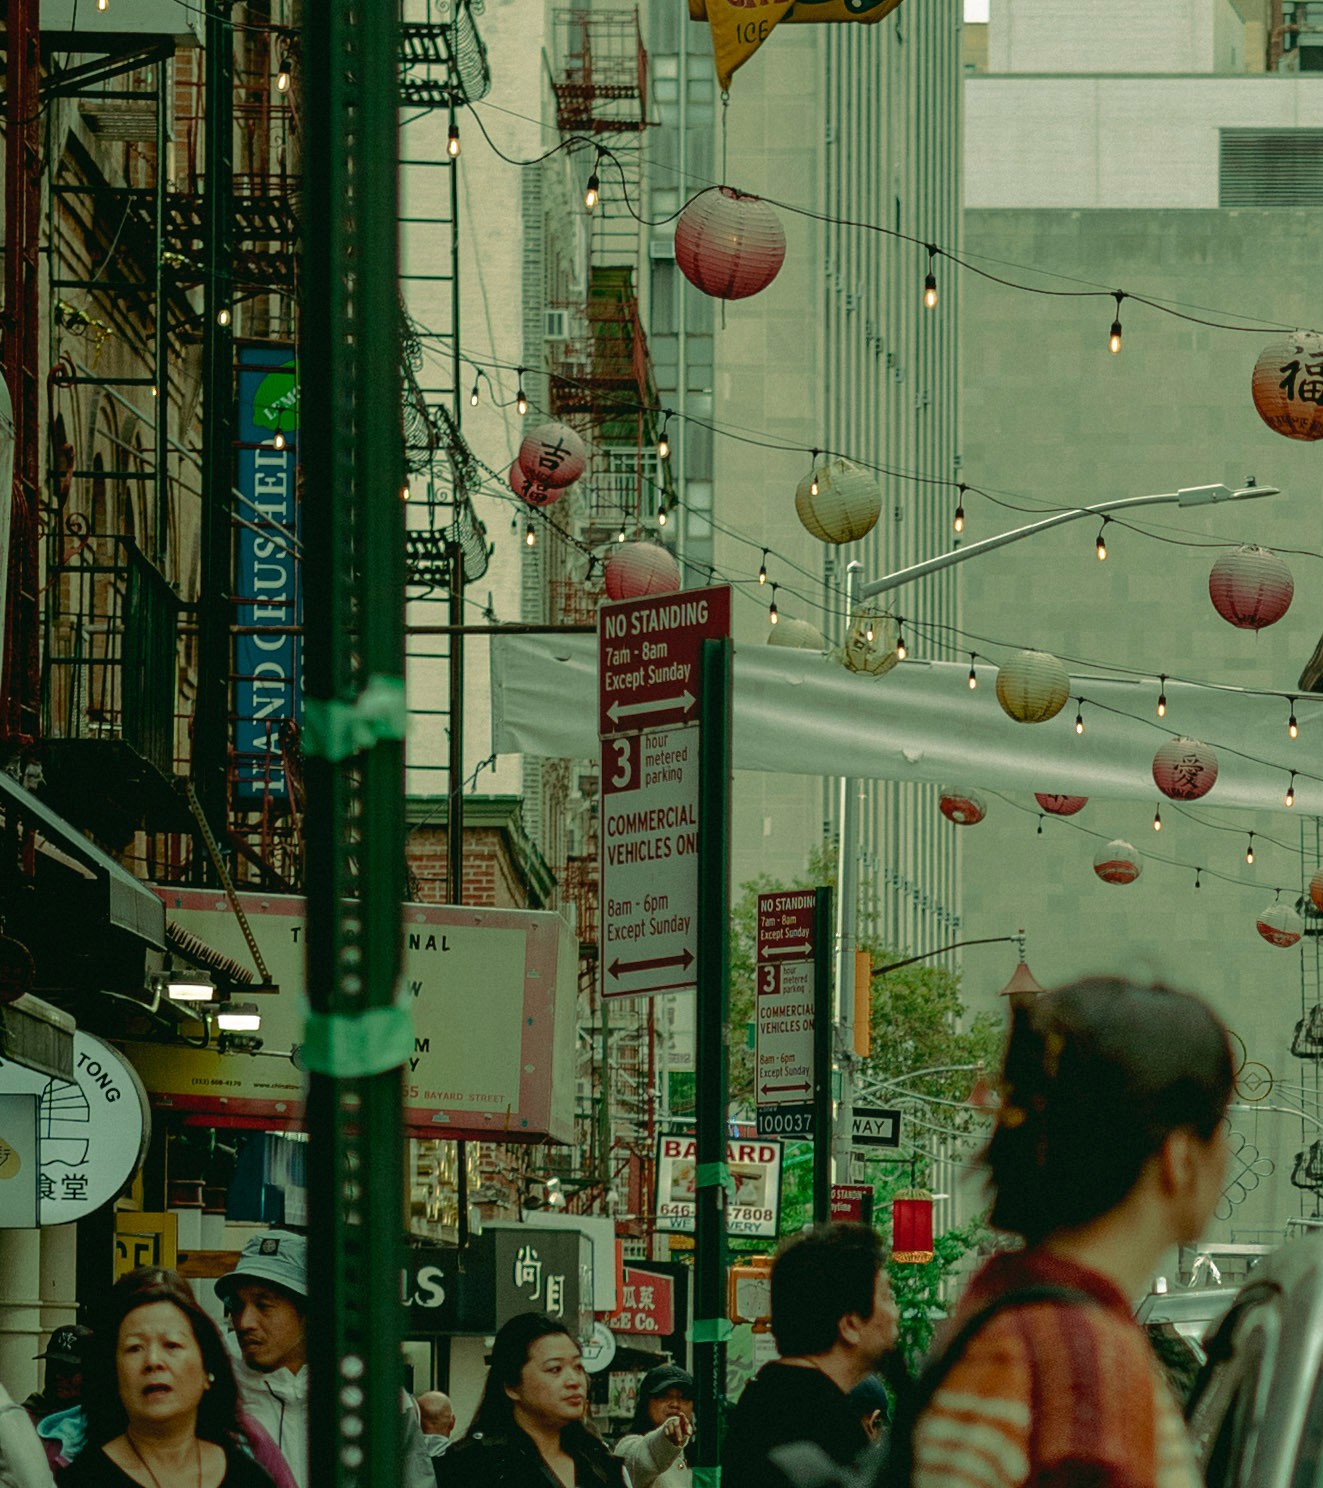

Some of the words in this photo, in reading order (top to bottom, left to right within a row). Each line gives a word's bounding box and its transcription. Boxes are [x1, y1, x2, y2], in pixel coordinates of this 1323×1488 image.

[737, 20, 768, 44] ICE
[540, 437, 572, 471] 吉
[252, 438, 288, 651] CRUSHED
[606, 614, 627, 640] NO
[631, 600, 708, 635] STANDING
[606, 647, 630, 666] 7am
[642, 642, 668, 661] 8am
[605, 667, 645, 691] Except
[648, 663, 691, 685] Sunday
[252, 662, 287, 793] HAND
[645, 733, 668, 750] hour
[611, 738, 632, 788] 3
[645, 748, 688, 768] metered
[645, 767, 683, 788] parking
[1173, 754, 1204, 788] 愛
[607, 804, 697, 838] COMMERCIAL
[608, 836, 672, 866] VEHICLES
[676, 832, 699, 856] ON
[608, 899, 632, 918] 8am
[644, 893, 669, 915] 6pm
[761, 898, 773, 913] NO
[607, 918, 646, 942] Except
[649, 914, 691, 936] Sunday
[761, 916, 775, 928] 7am
[781, 915, 797, 926] 8am
[761, 928, 783, 941] Except
[785, 925, 810, 939] Sunday
[763, 965, 776, 993] 3
[783, 967, 797, 975] hour
[783, 974, 808, 985] metered
[783, 984, 805, 995] parking
[760, 1019, 801, 1035] VEHICLES
[760, 1053, 775, 1065] 8am
[780, 1053, 796, 1066] 6pm
[760, 1065, 783, 1079] Except
[785, 1063, 810, 1078] Sunday
[76, 1052, 121, 1104] TONG
[424, 1090, 463, 1101] BAYARD
[468, 1093, 505, 1104] STREET
[759, 1113, 812, 1134] 100037
[664, 1139, 776, 1164] BAARD
[40, 1172, 89, 1202] 食堂
[634, 1313, 658, 1331] Co.
